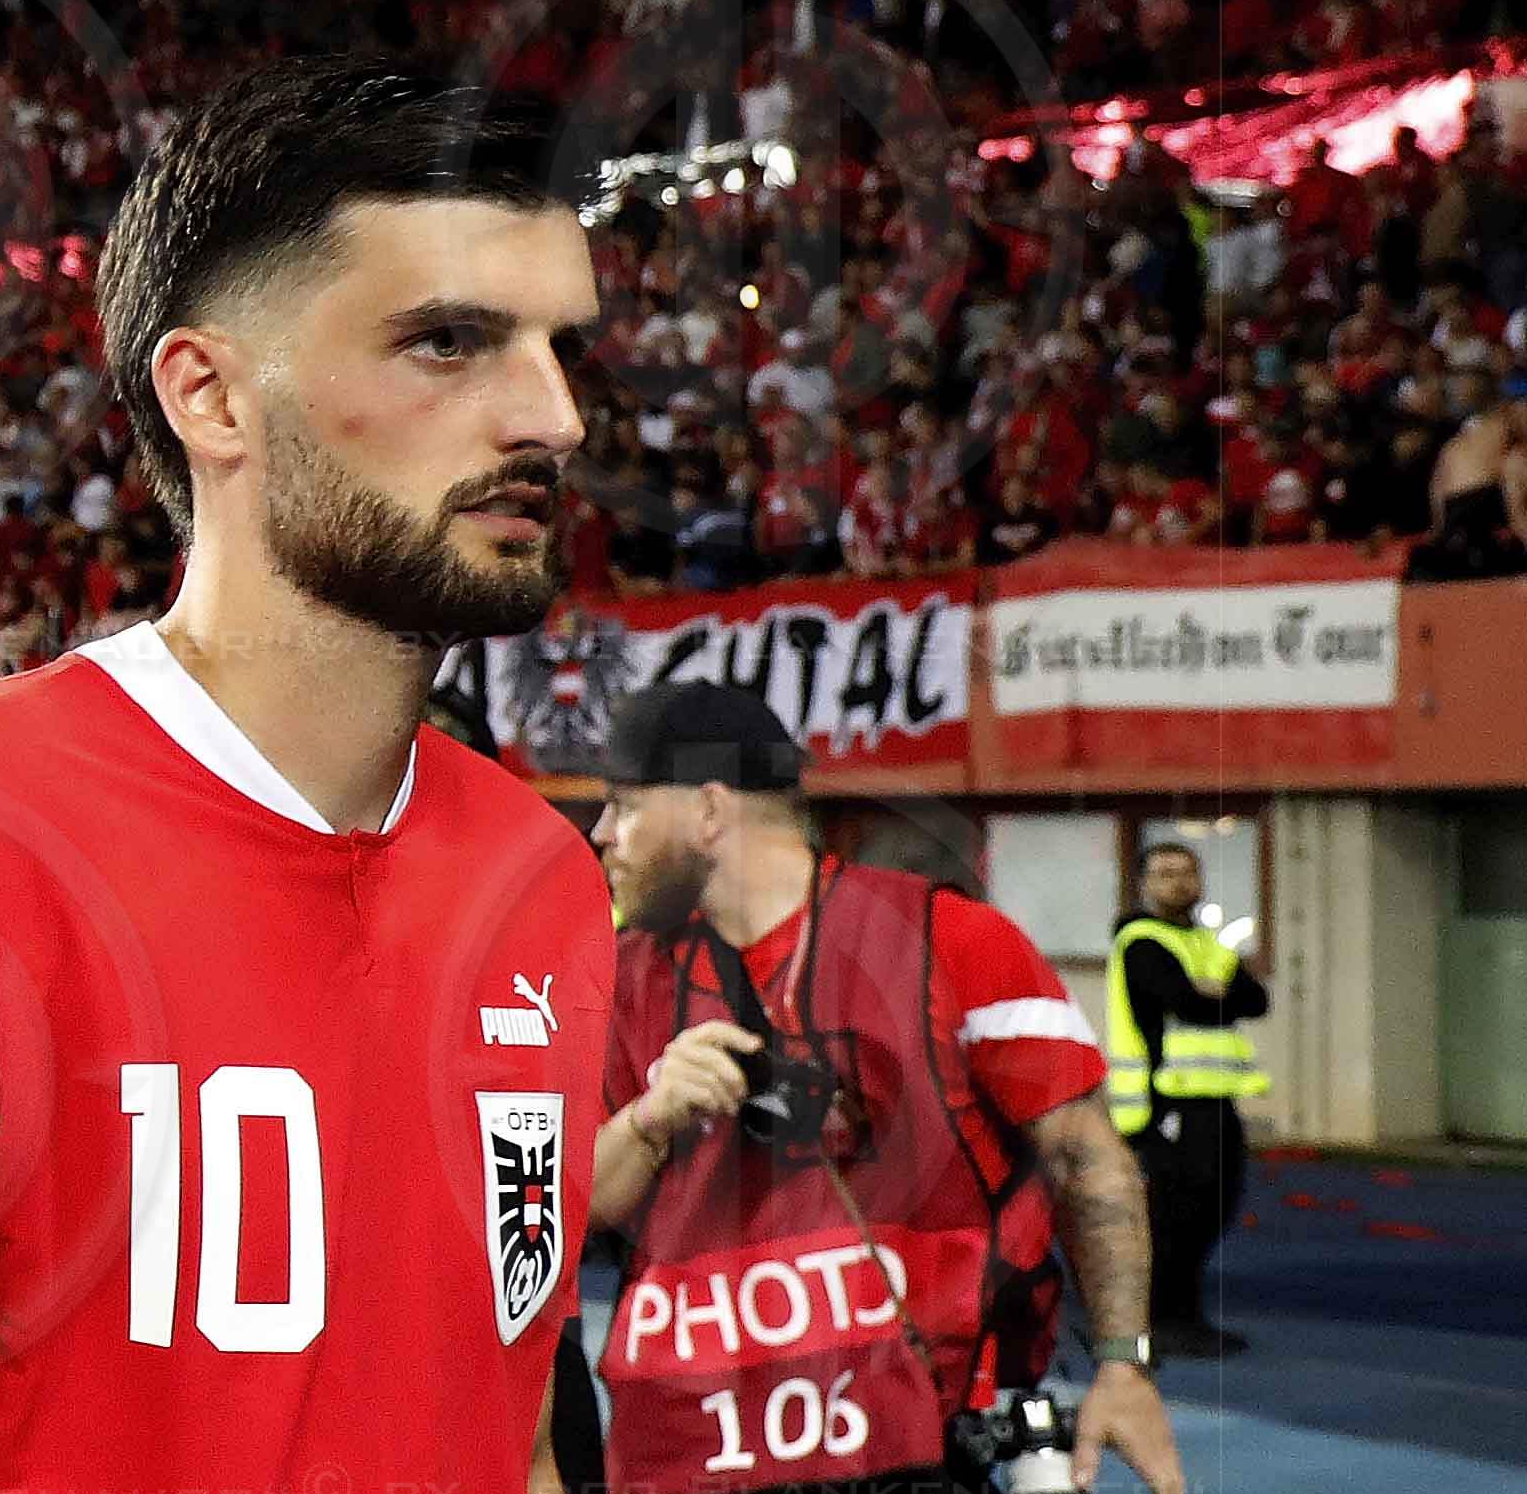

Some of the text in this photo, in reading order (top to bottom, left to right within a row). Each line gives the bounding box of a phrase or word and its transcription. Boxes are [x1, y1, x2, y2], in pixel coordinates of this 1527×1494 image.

[507, 1107, 549, 1132] ÖFB
[119, 1061, 325, 1354] 10
[624, 1244, 909, 1364] PHOTO
[701, 1370, 870, 1473] 106
